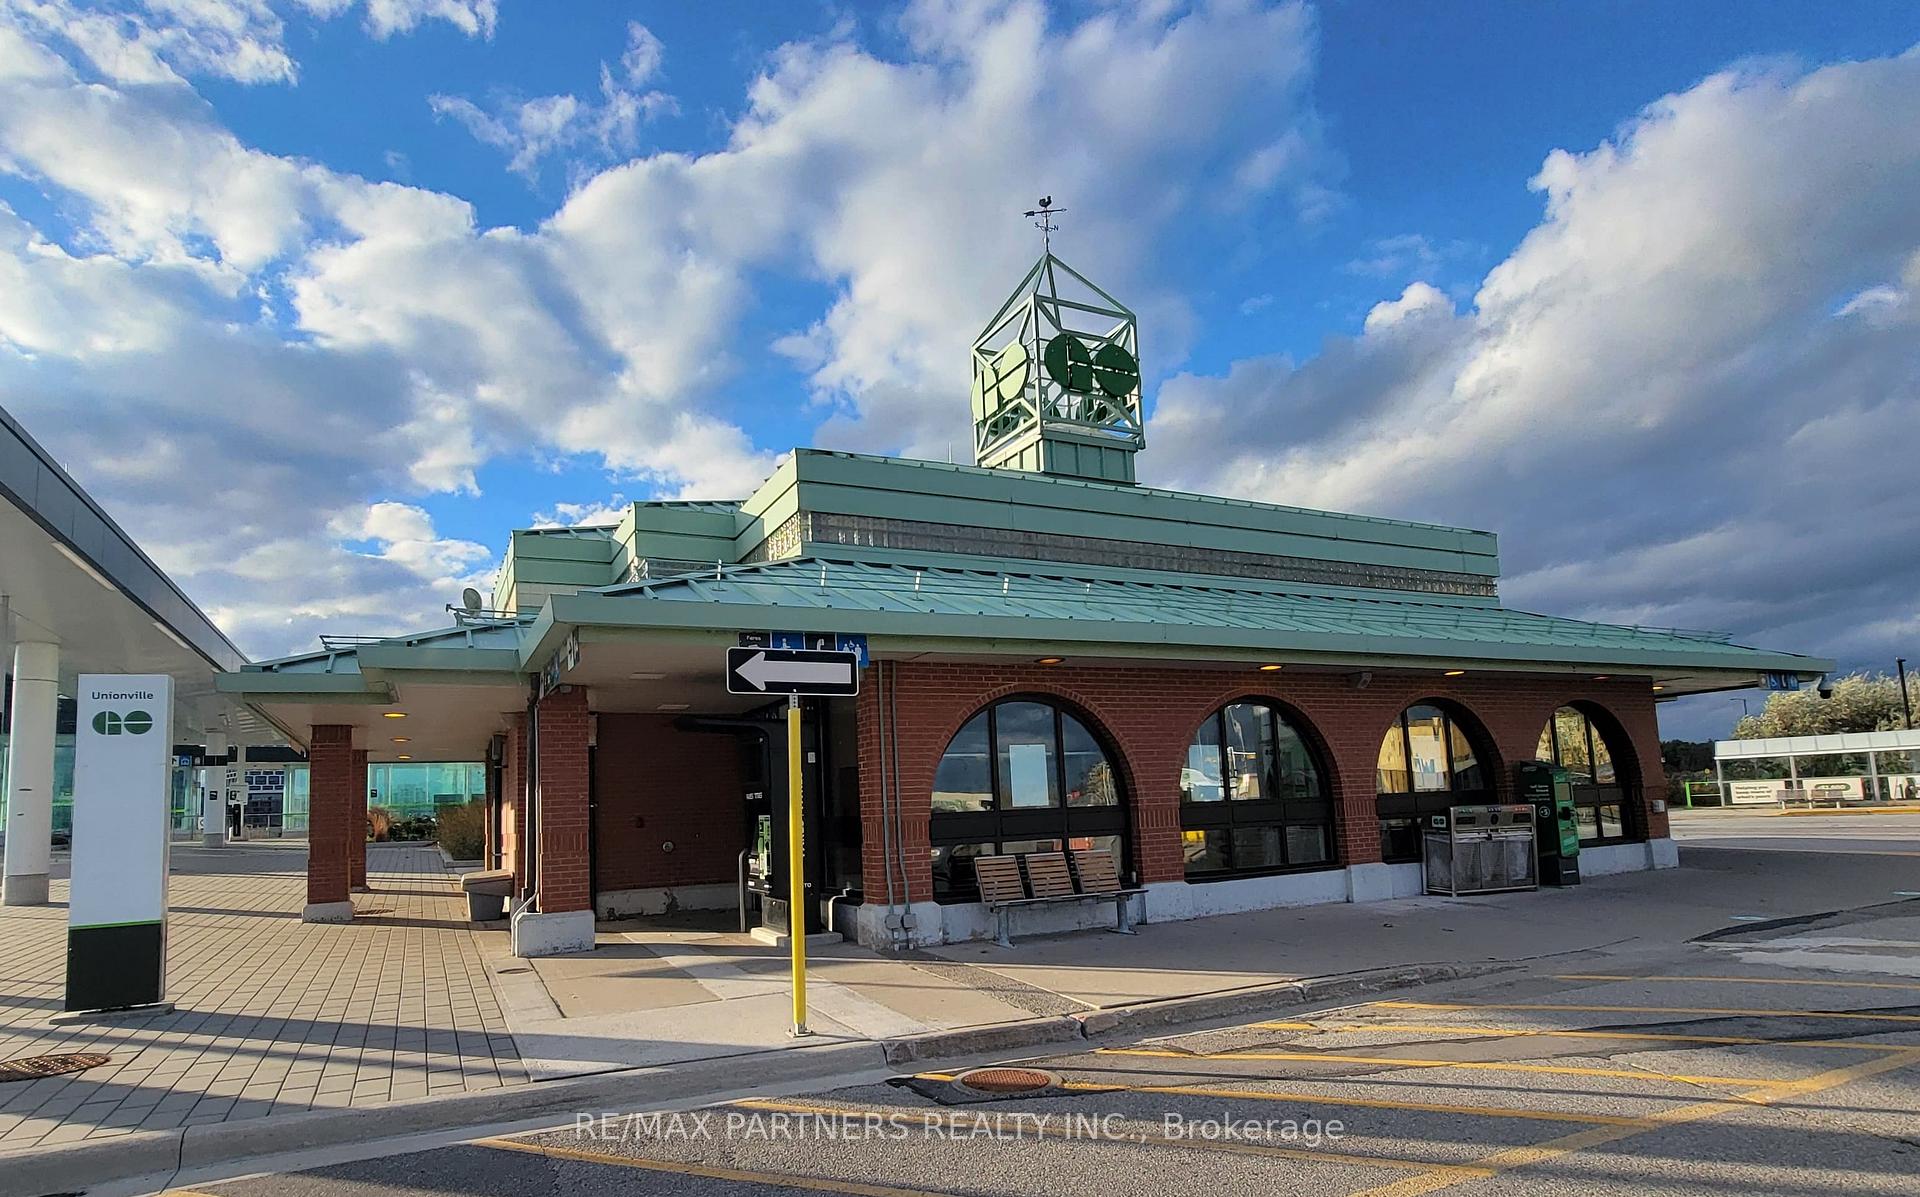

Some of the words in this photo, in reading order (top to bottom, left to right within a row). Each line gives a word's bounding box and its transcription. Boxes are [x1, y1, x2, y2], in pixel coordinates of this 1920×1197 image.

[1044, 334, 1138, 398] GO
[92, 691, 154, 699] Unionville
[92, 710, 153, 735] GO
